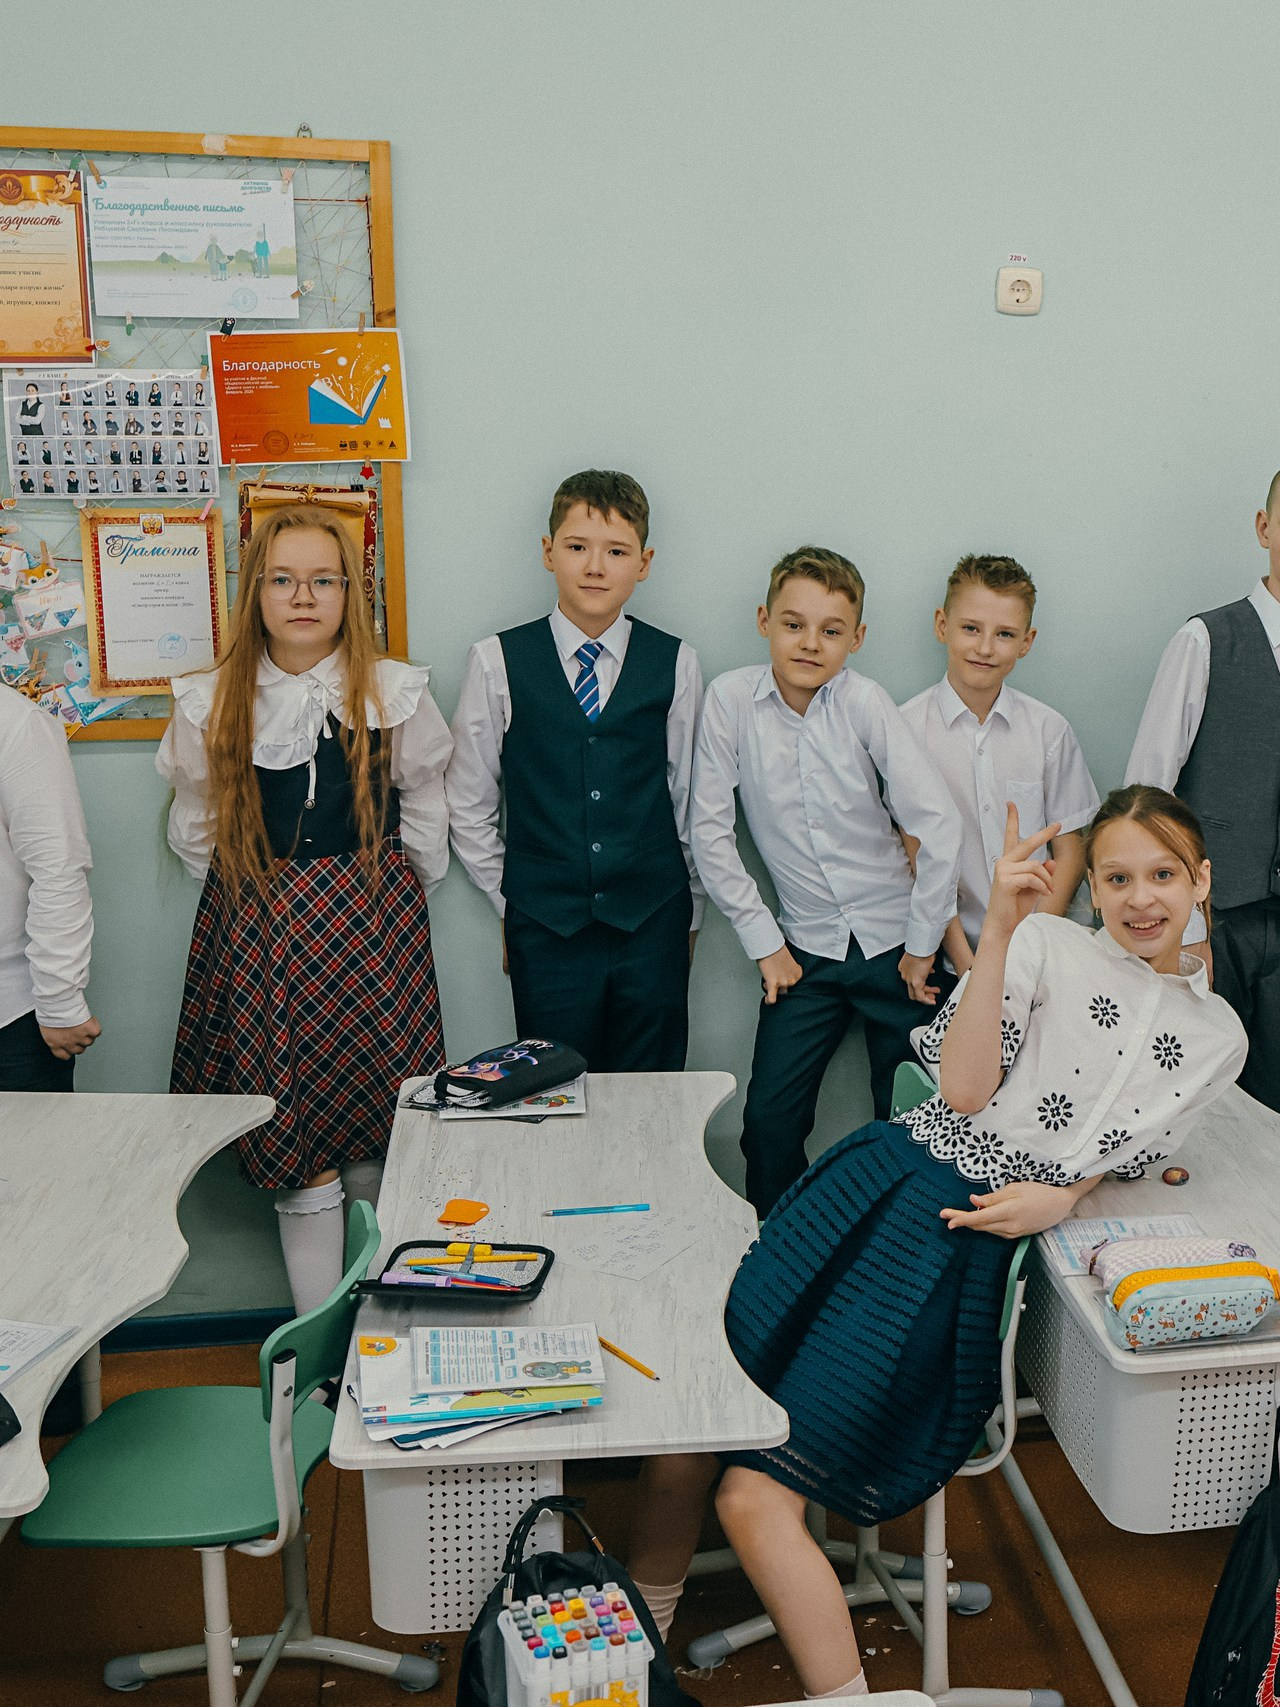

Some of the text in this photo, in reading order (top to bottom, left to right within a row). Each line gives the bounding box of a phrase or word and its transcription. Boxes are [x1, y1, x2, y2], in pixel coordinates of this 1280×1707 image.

[92, 198, 245, 217] Благодарственное письмо
[222, 359, 321, 373] Благодарность
[106, 535, 200, 564] Грамота
